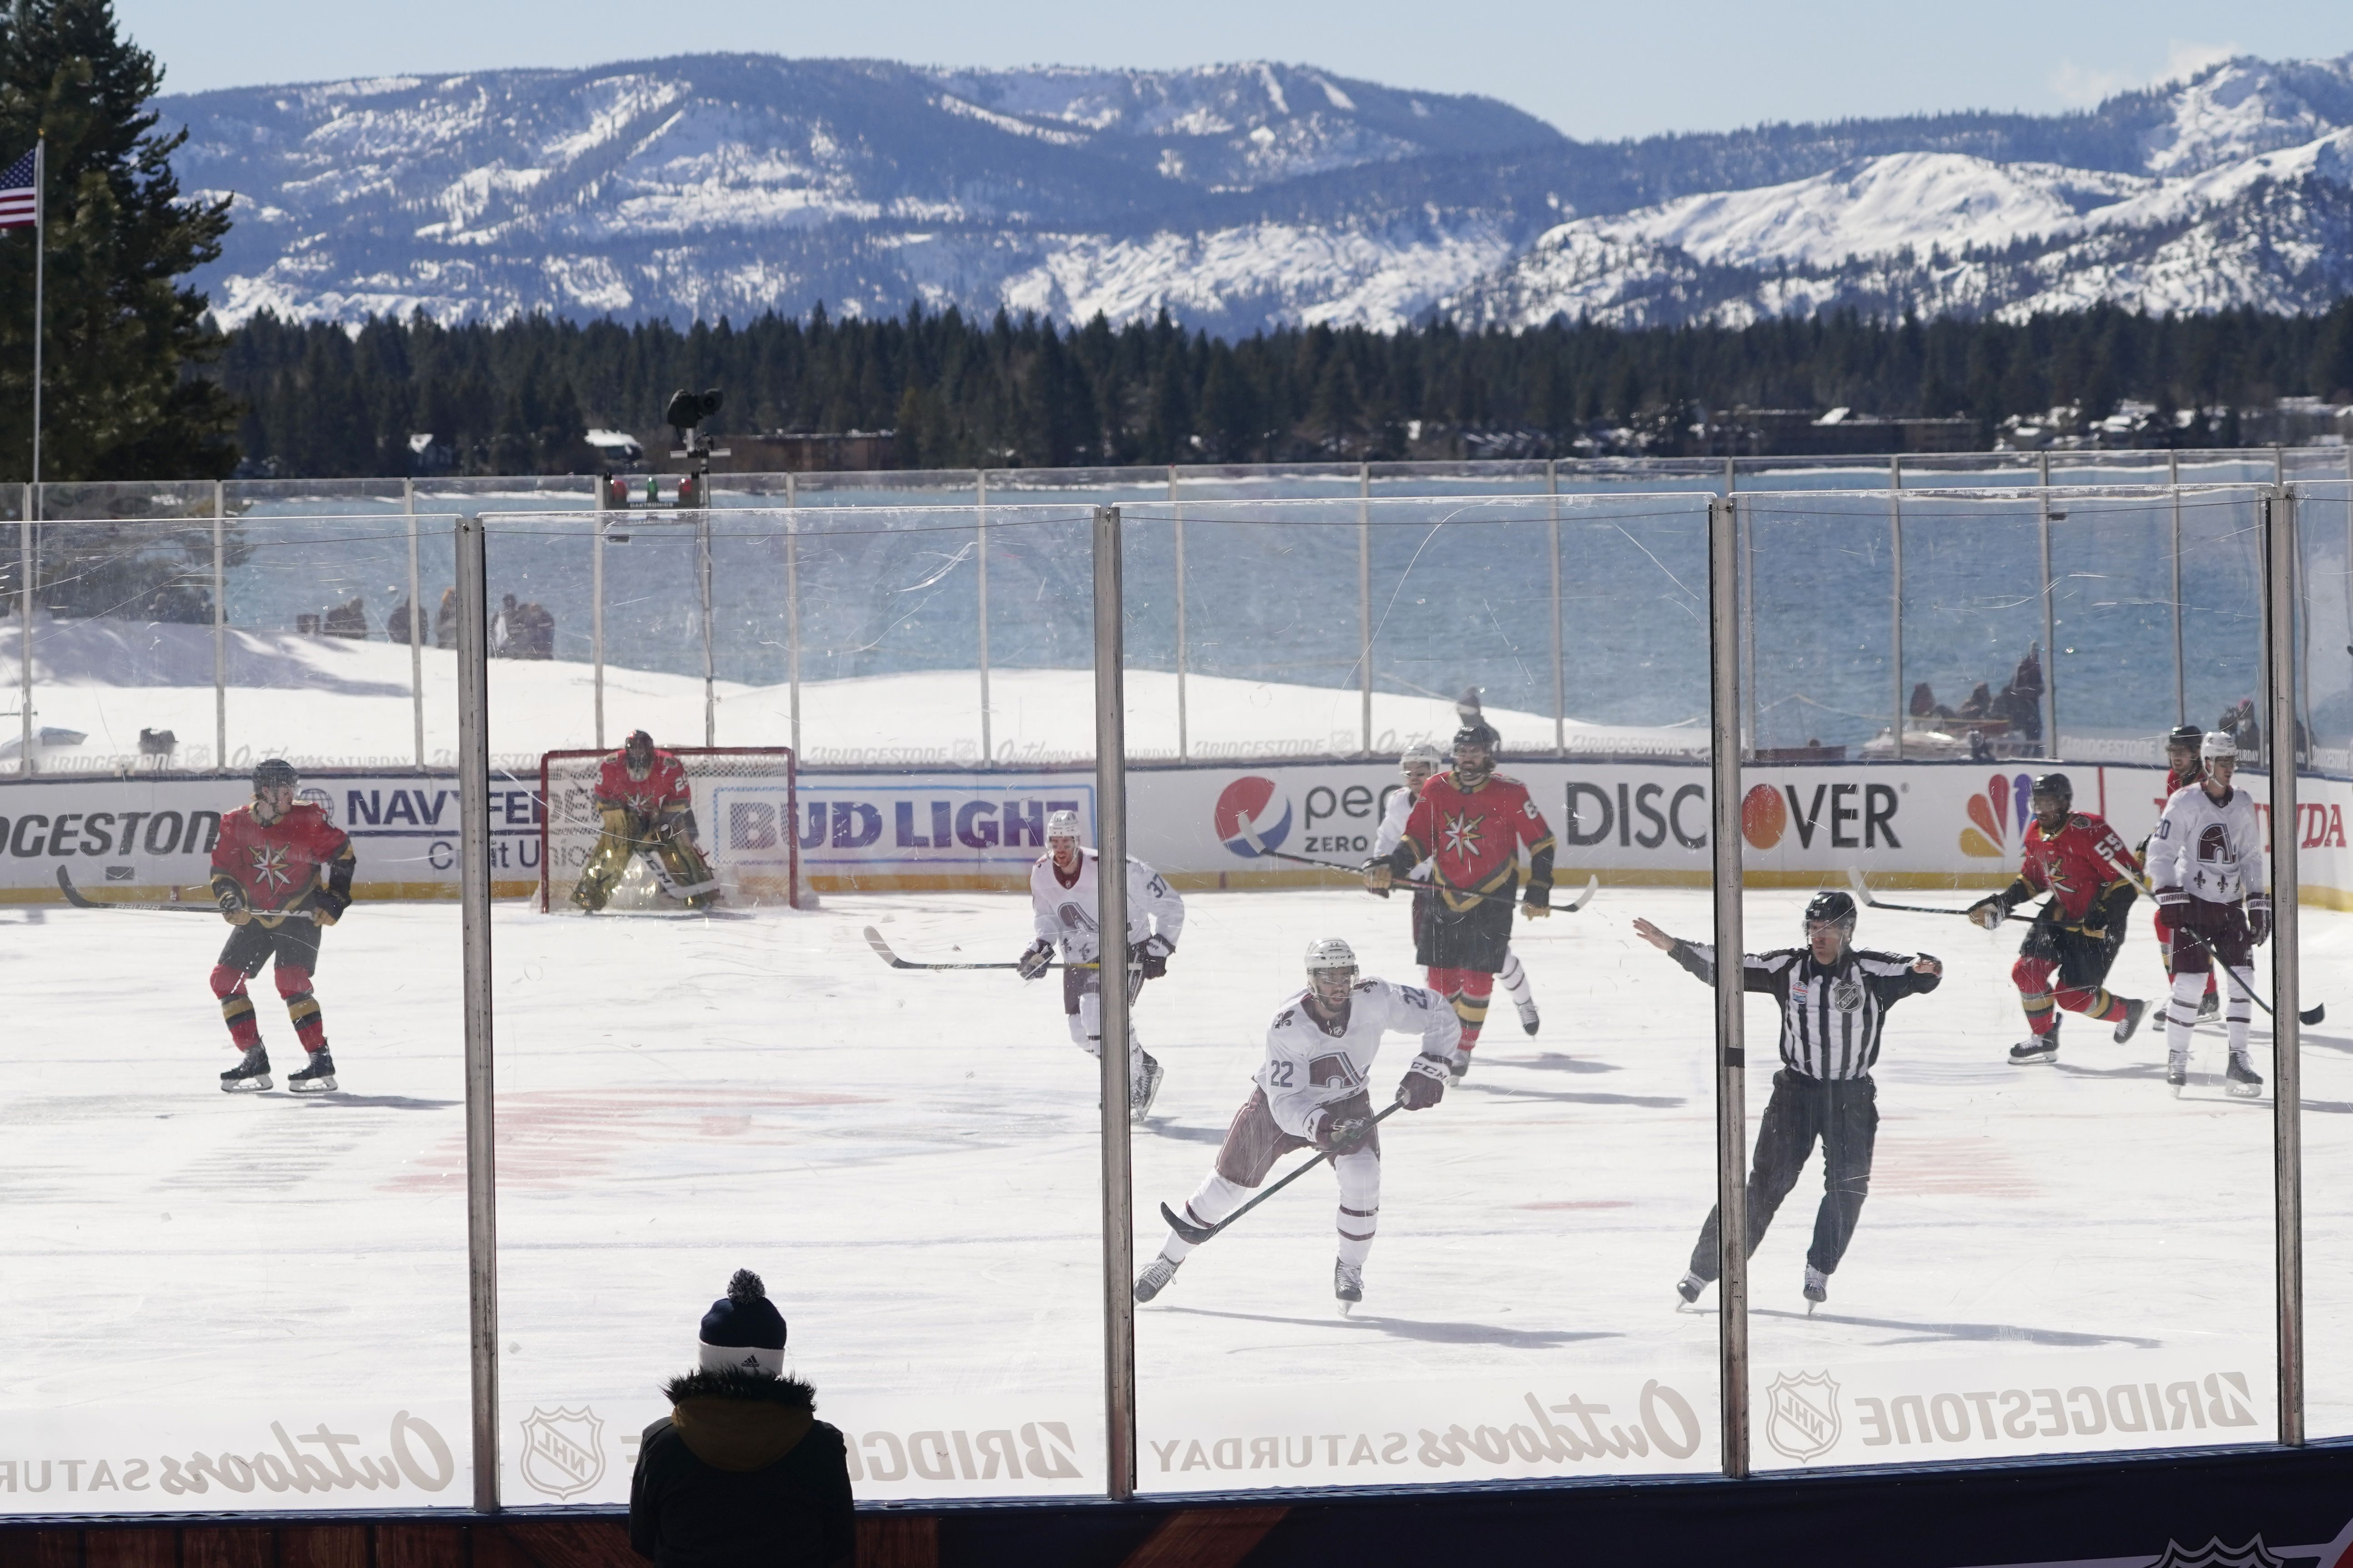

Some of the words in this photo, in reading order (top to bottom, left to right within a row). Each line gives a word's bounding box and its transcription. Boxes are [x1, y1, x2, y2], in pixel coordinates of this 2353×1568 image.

[808, 746, 949, 765] BRIDGESTONE
[996, 739, 1073, 765] Outdoors
[1194, 738, 1325, 757] BRIDGESTONE
[1570, 735, 1686, 755] BRIDGESTONE
[2059, 735, 2157, 758] BRIDGESTONE
[327, 756, 411, 767] SATURDAY
[347, 790, 461, 825] NAV
[1565, 782, 1903, 850] DISCOVER
[0, 811, 222, 857] GESTON
[729, 801, 883, 851] BUD
[1305, 835, 1368, 853] ZERO
[2094, 832, 2125, 862] 55
[1147, 873, 1167, 899] 37
[1840, 988, 1858, 1008] NHL
[1271, 1060, 1294, 1088] 22
[1411, 1061, 1448, 1080] CCM
